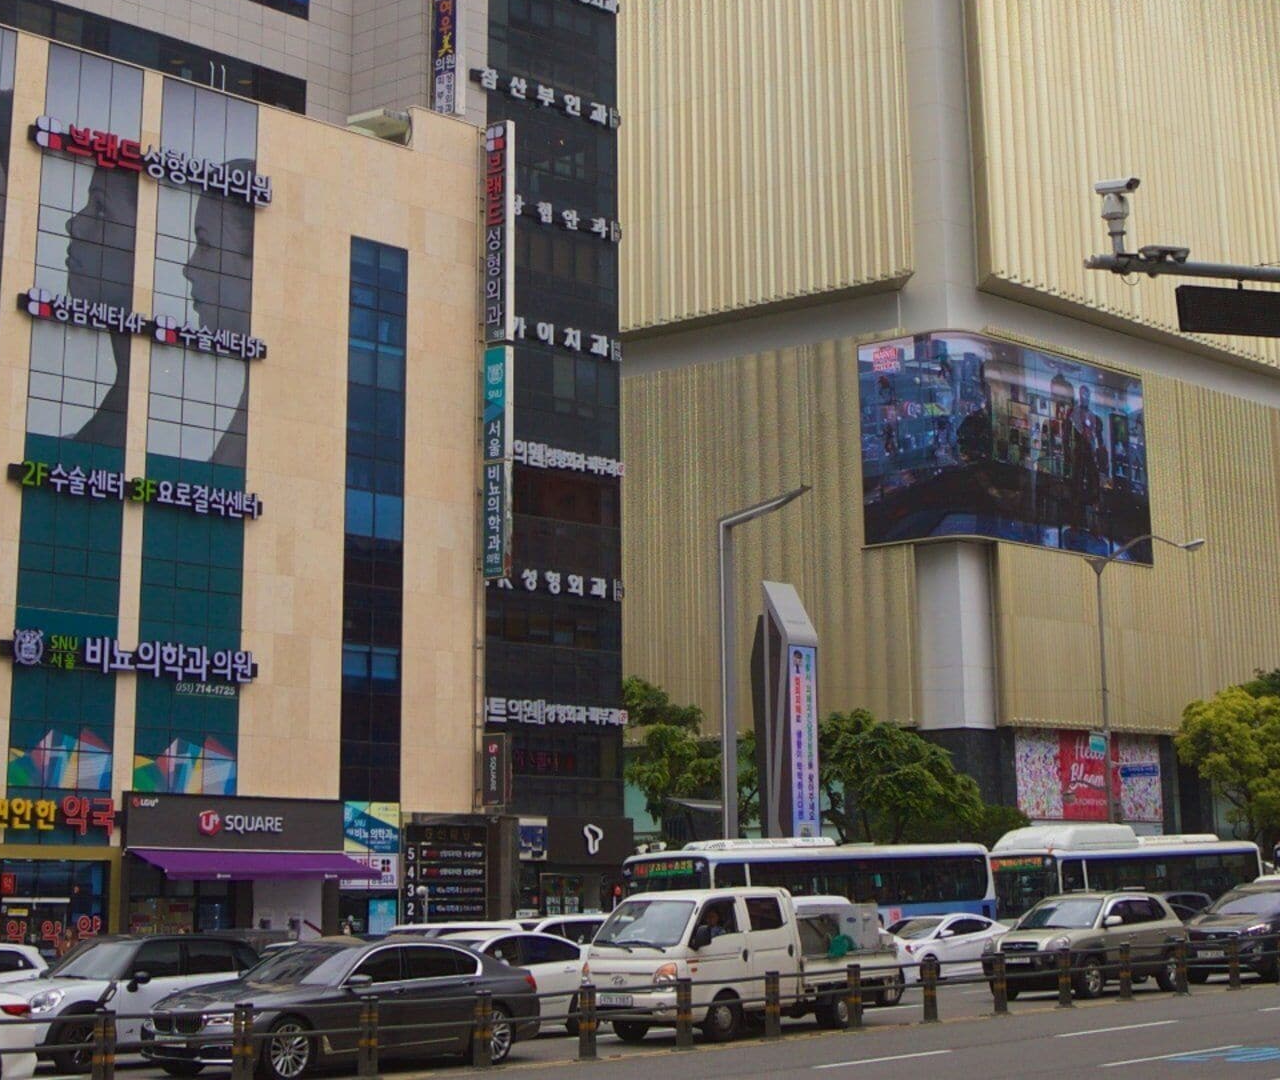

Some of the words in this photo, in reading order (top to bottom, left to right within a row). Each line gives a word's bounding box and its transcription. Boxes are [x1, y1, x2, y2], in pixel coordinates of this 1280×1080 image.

[485, 227, 503, 326] 성형외과
[488, 420, 501, 457] 서울
[22, 461, 47, 486] 2F
[132, 477, 156, 502] 3F
[487, 465, 501, 551] 비뇨의학과
[50, 635, 78, 651] SNU
[50, 652, 77, 669] 서울
[62, 796, 115, 836] 약국
[224, 815, 283, 833] SQUARE
[407, 848, 415, 860] 5
[407, 866, 415, 879] 4
[407, 885, 415, 897] 3
[407, 904, 415, 916] 2
[6, 921, 27, 943] 약
[41, 921, 62, 946] 약
[77, 916, 101, 939] 약
